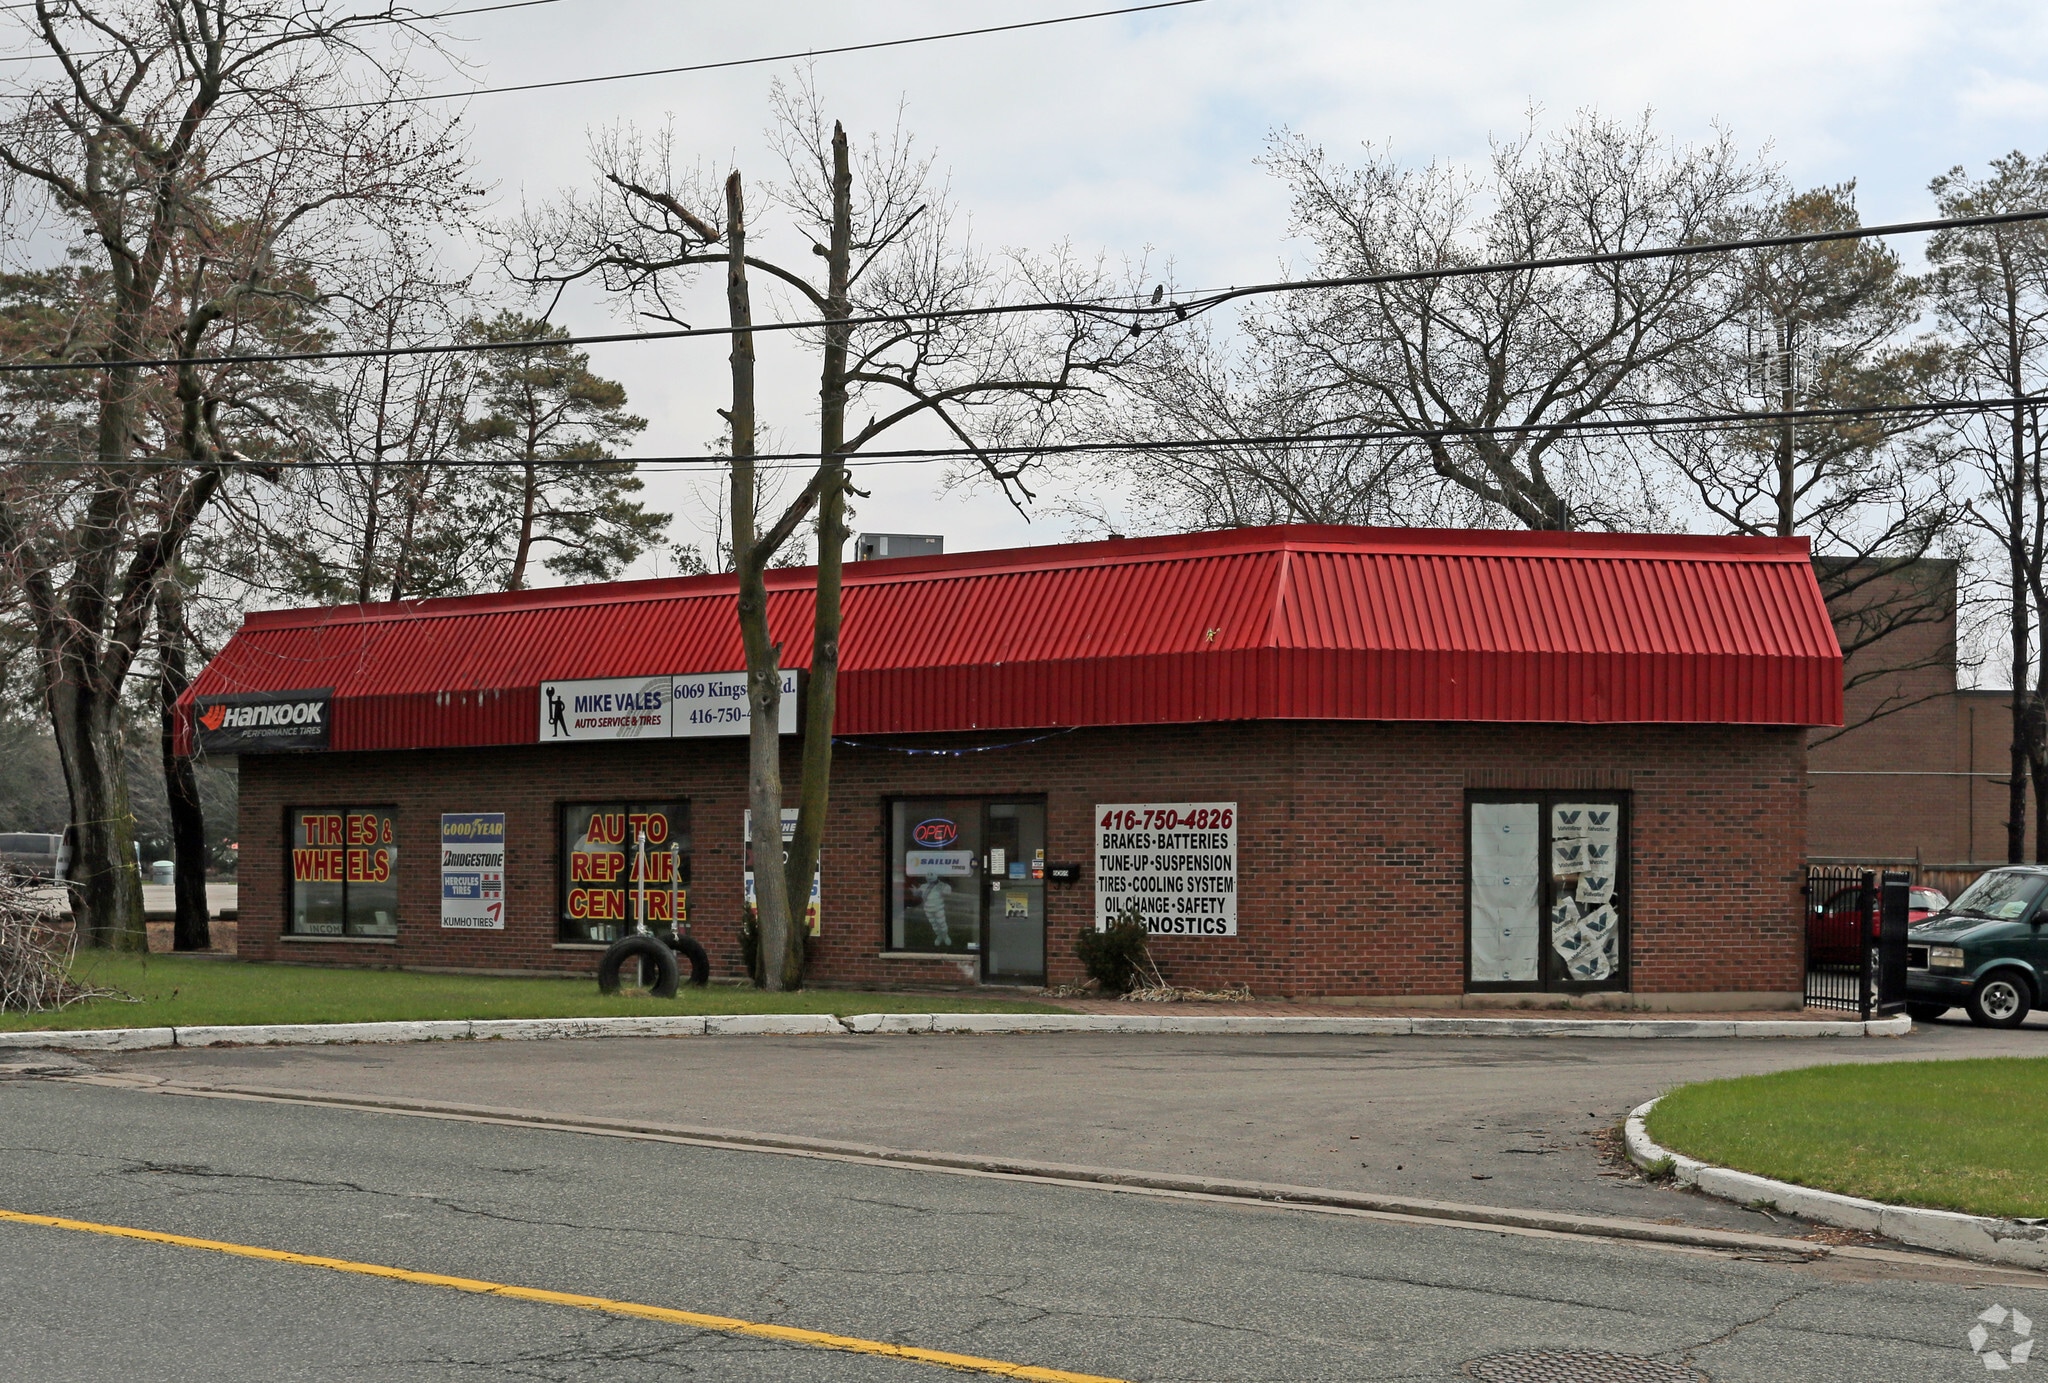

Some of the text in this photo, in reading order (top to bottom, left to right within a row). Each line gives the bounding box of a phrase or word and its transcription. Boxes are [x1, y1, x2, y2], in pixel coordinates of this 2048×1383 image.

[674, 677, 796, 701] 6069 Kings d.
[574, 691, 662, 713] MIKE VALES
[575, 715, 662, 729] AUTO SERVICE & TIRES
[241, 726, 321, 738] PERFORMANCE TIRES
[1100, 809, 1233, 830] 416-750-4826
[302, 814, 393, 846] TIRES &
[443, 821, 503, 837] GOODYEAR
[586, 813, 668, 845] AUTO
[916, 824, 957, 840] OPEN
[1102, 833, 1228, 849] BRAKES BATTERIES
[292, 848, 390, 883] WHEELS
[443, 850, 504, 867] BRIDGESTONE
[571, 851, 683, 883] REPAIR
[1100, 855, 1232, 871] TUNE-UP SUSPENSION
[444, 876, 479, 886] HERCULES
[1099, 876, 1234, 893] TIRES COOLING SYSTEM
[452, 886, 472, 896] TIRES
[568, 888, 687, 921] CENTRE
[1105, 897, 1226, 914] OIL CHANGE SAFETY
[309, 923, 343, 934] INCOM
[443, 917, 494, 928] KUMHO TIRES
